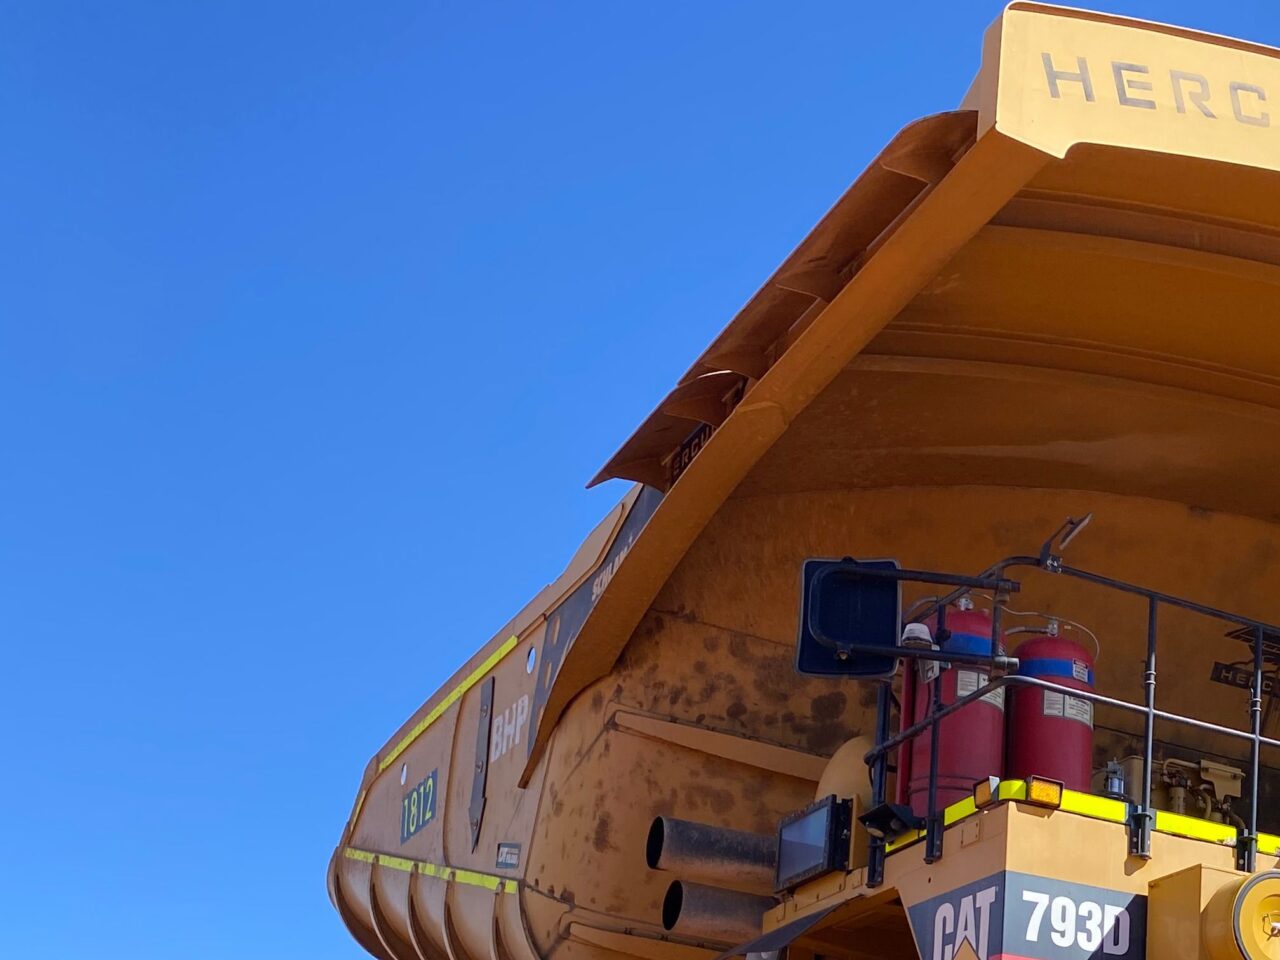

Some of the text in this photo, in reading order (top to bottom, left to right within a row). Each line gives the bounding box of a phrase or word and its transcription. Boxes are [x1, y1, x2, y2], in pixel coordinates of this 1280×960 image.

[491, 694, 528, 763] BHP
[404, 777, 433, 838] 1812
[1022, 890, 1130, 957] 793D
